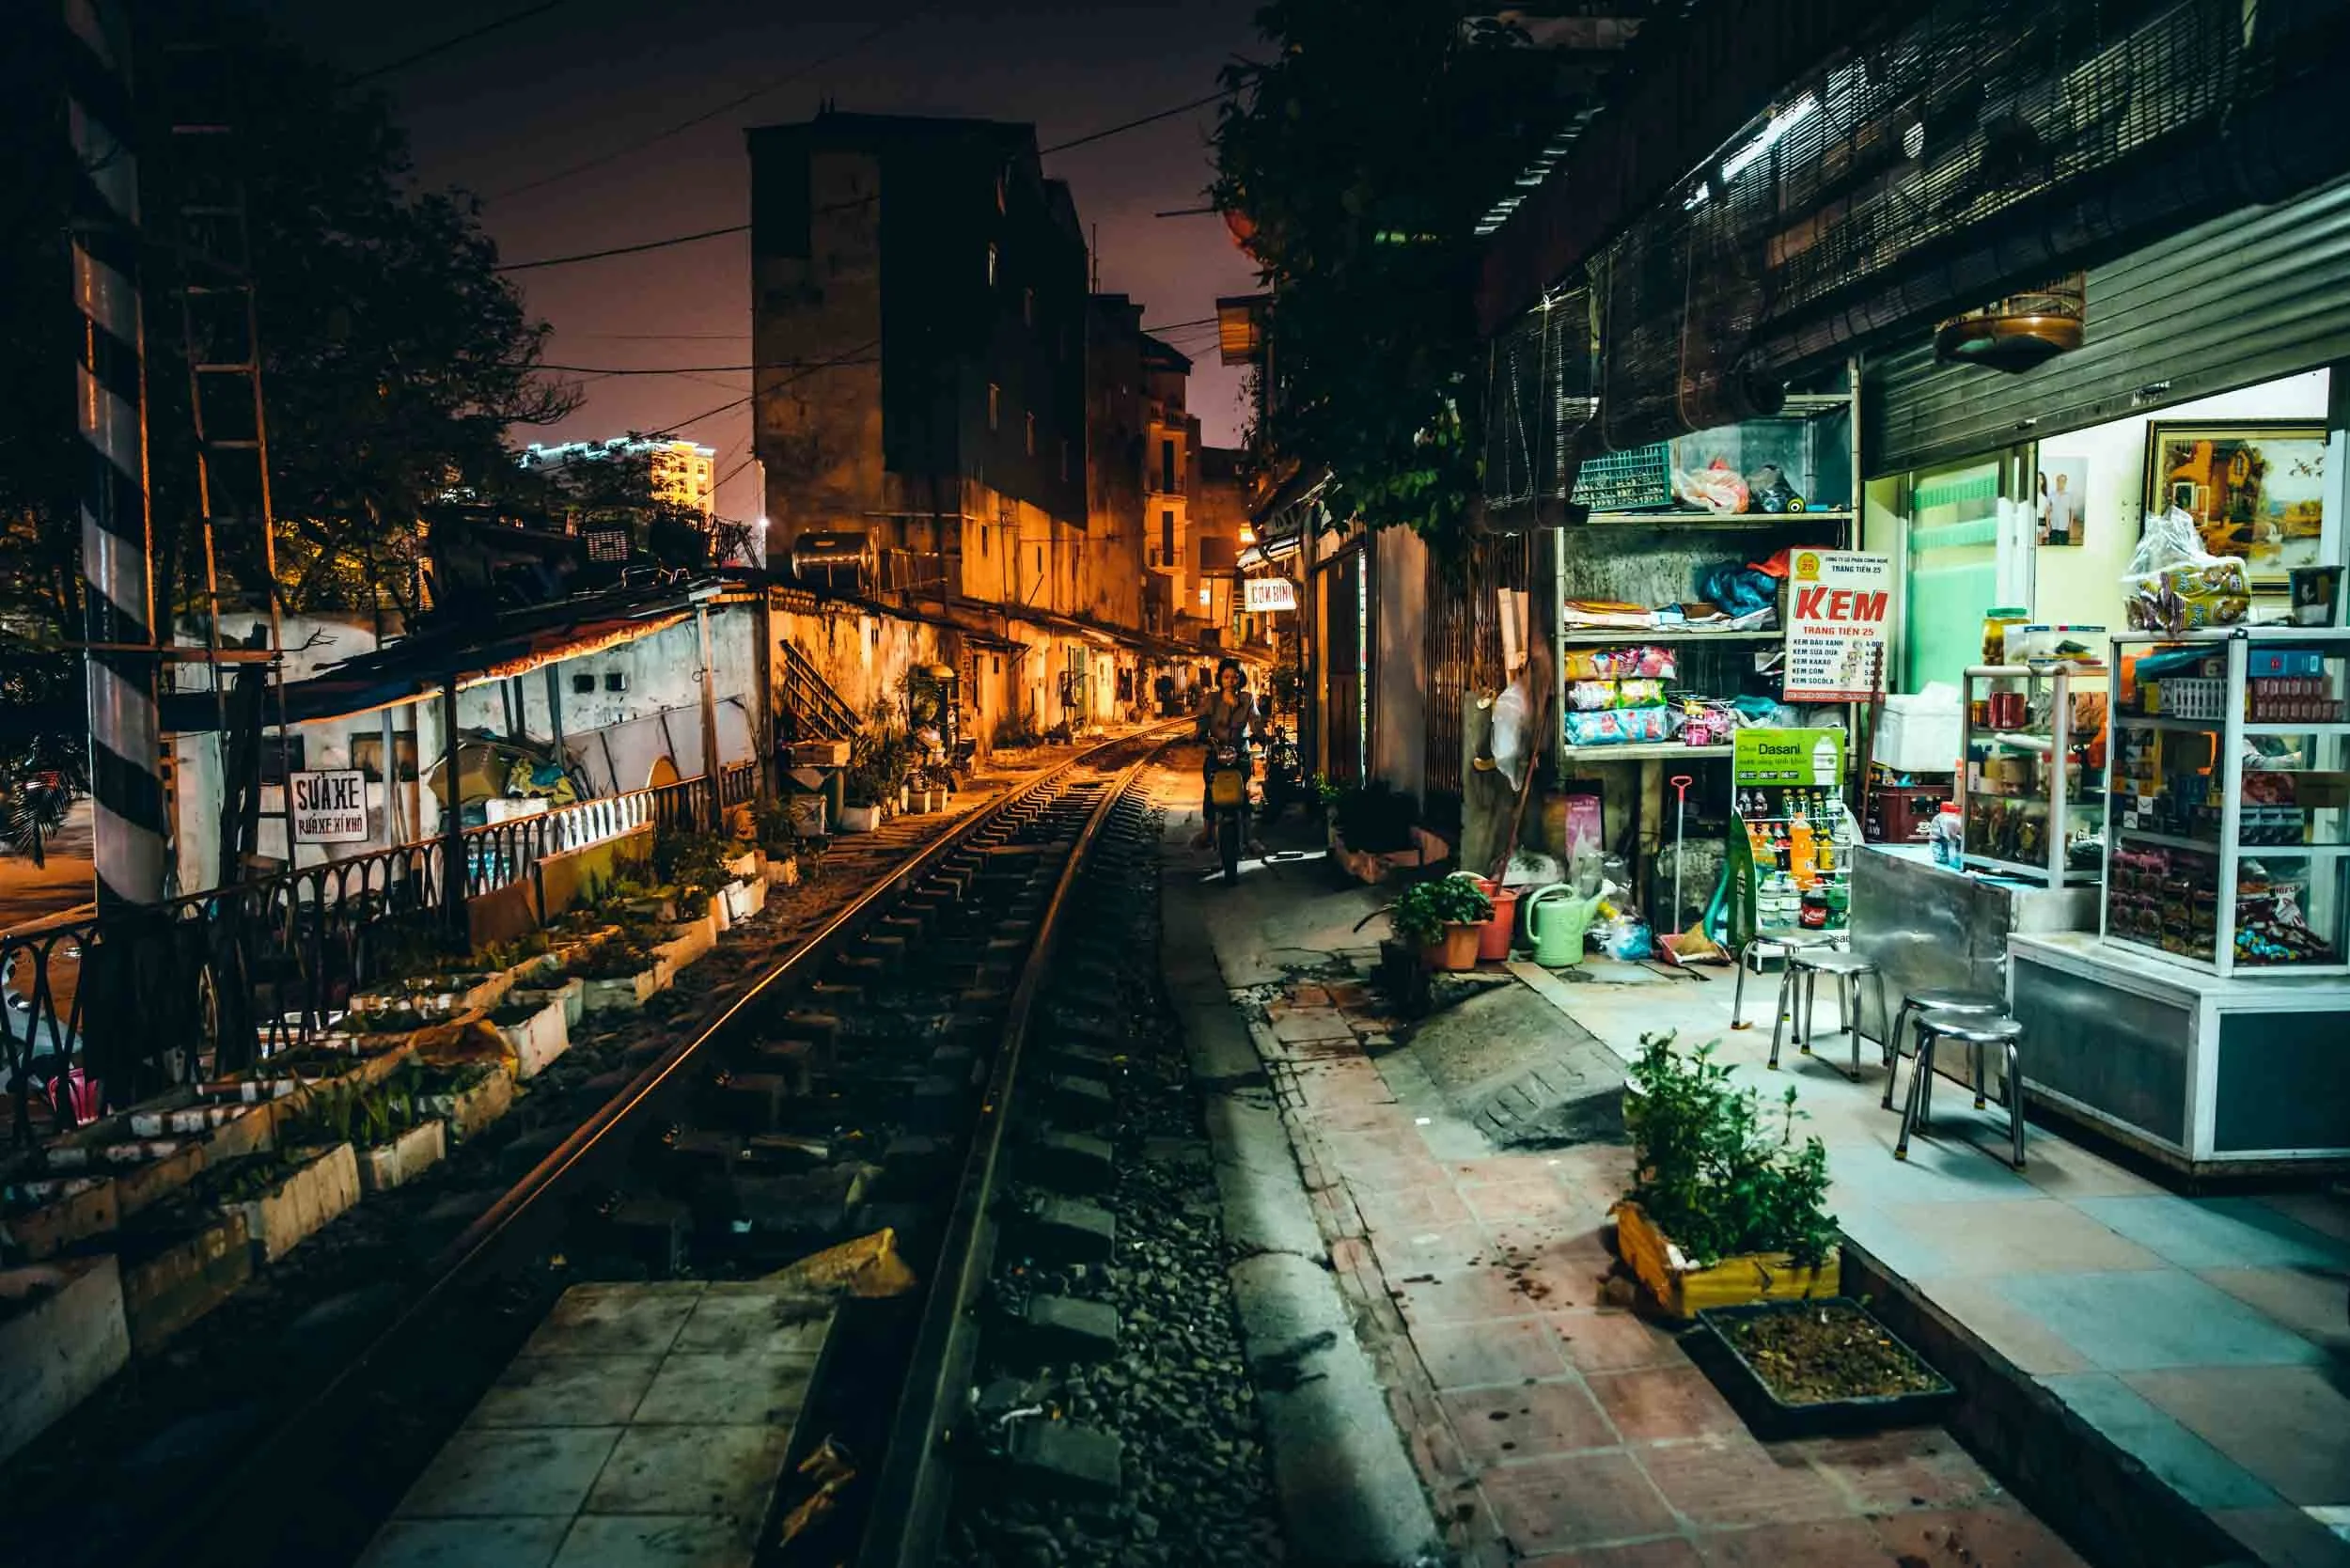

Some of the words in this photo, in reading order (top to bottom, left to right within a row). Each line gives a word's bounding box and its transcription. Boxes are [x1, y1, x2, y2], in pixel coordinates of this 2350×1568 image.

[1794, 585, 1888, 622] KEM
[1863, 627, 1874, 636] 25
[1759, 743, 1800, 755] Dasani
